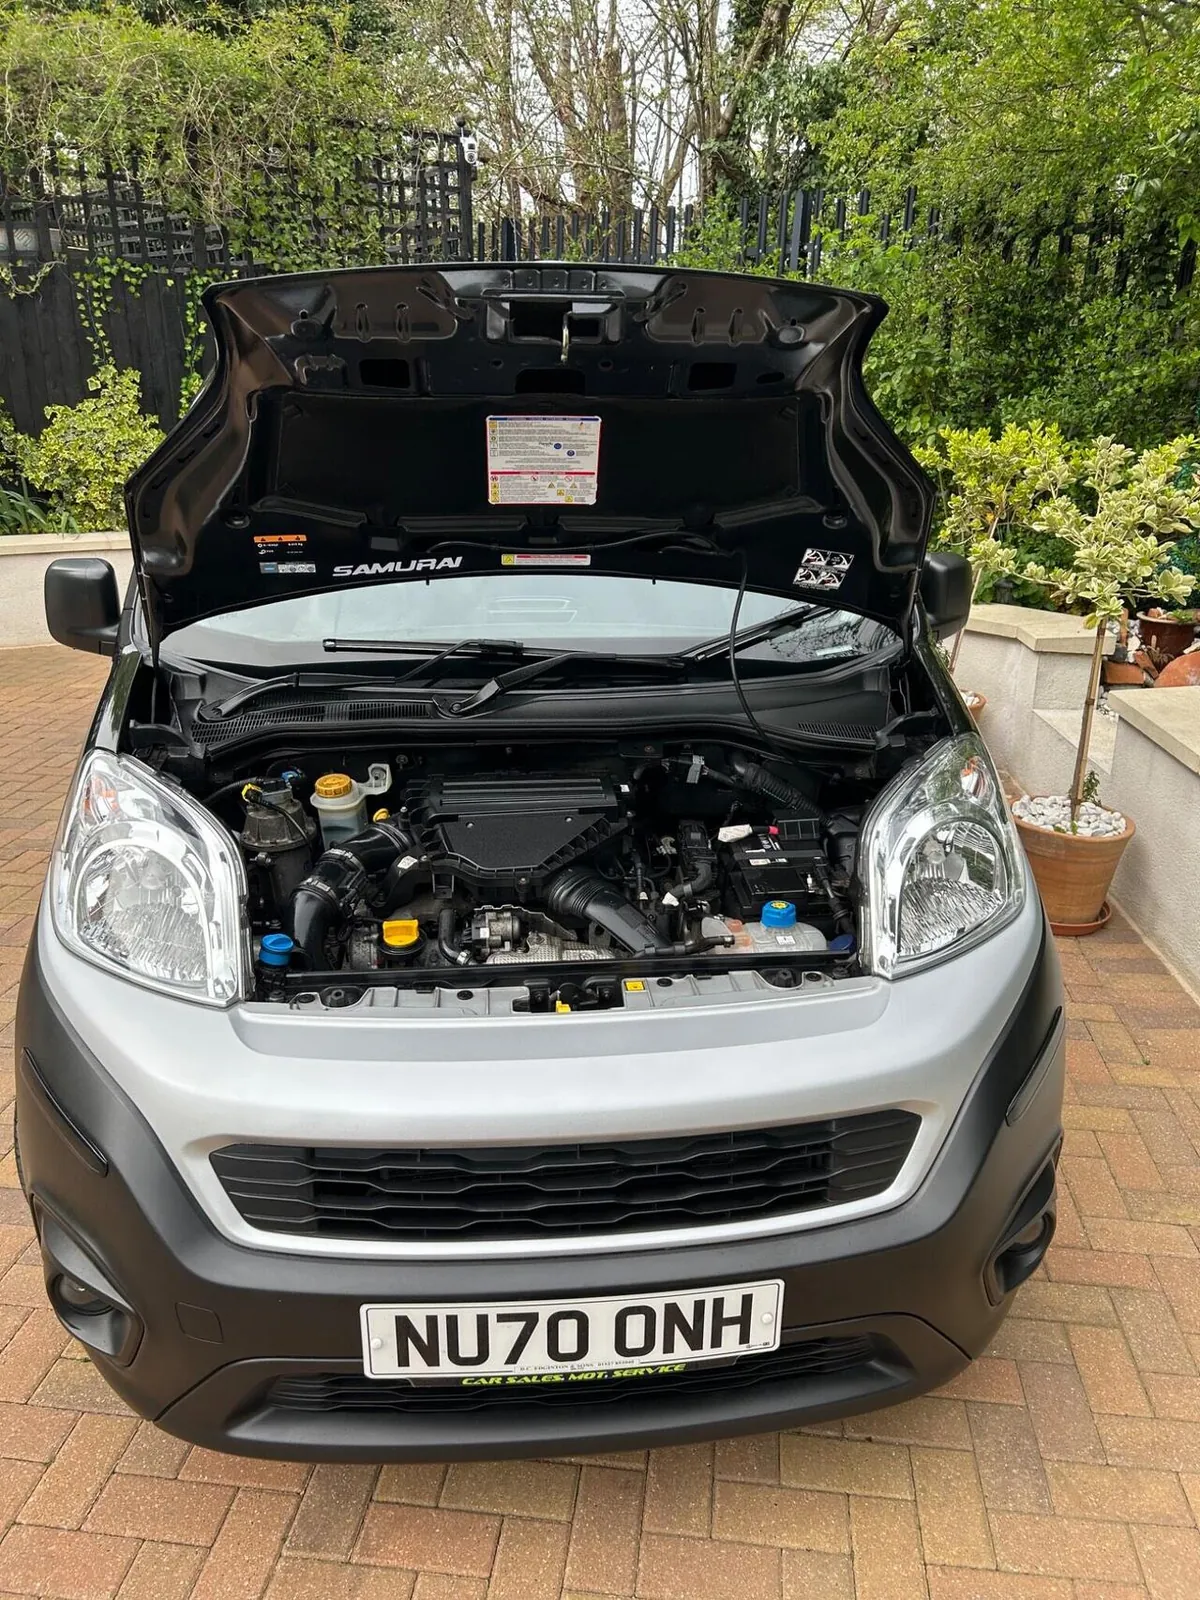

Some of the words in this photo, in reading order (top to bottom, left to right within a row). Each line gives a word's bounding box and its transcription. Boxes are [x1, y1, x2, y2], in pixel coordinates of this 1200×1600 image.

[332, 556, 463, 577] SAMURAI
[394, 1310, 590, 1368] NU70
[614, 1293, 754, 1358] ONH
[461, 1376, 502, 1386] CAR
[611, 1362, 687, 1378] SERVICE
